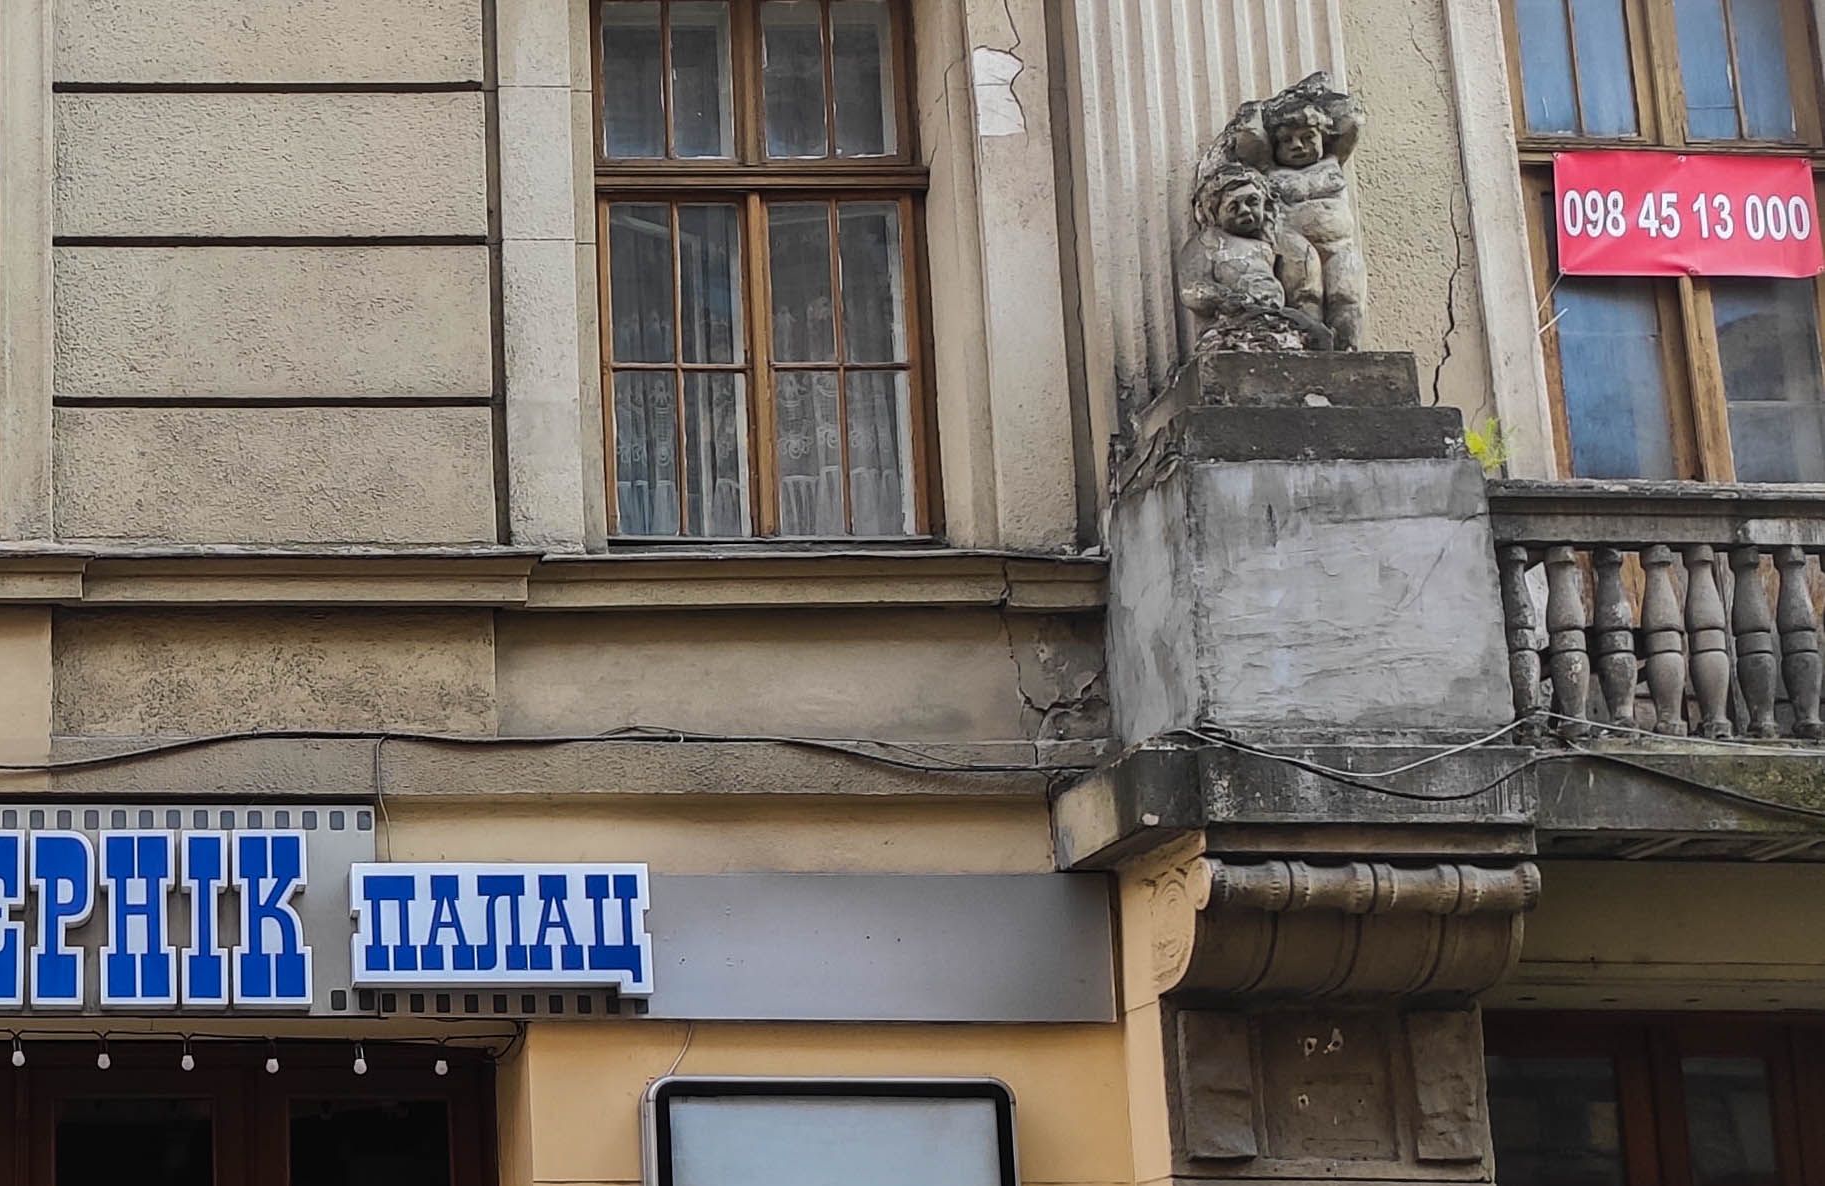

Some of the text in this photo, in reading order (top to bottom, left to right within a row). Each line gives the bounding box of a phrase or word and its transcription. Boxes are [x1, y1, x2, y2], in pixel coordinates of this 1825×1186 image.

[1562, 190, 1811, 241] 098 45 13 000
[363, 873, 644, 984] ПАЛАЦ
